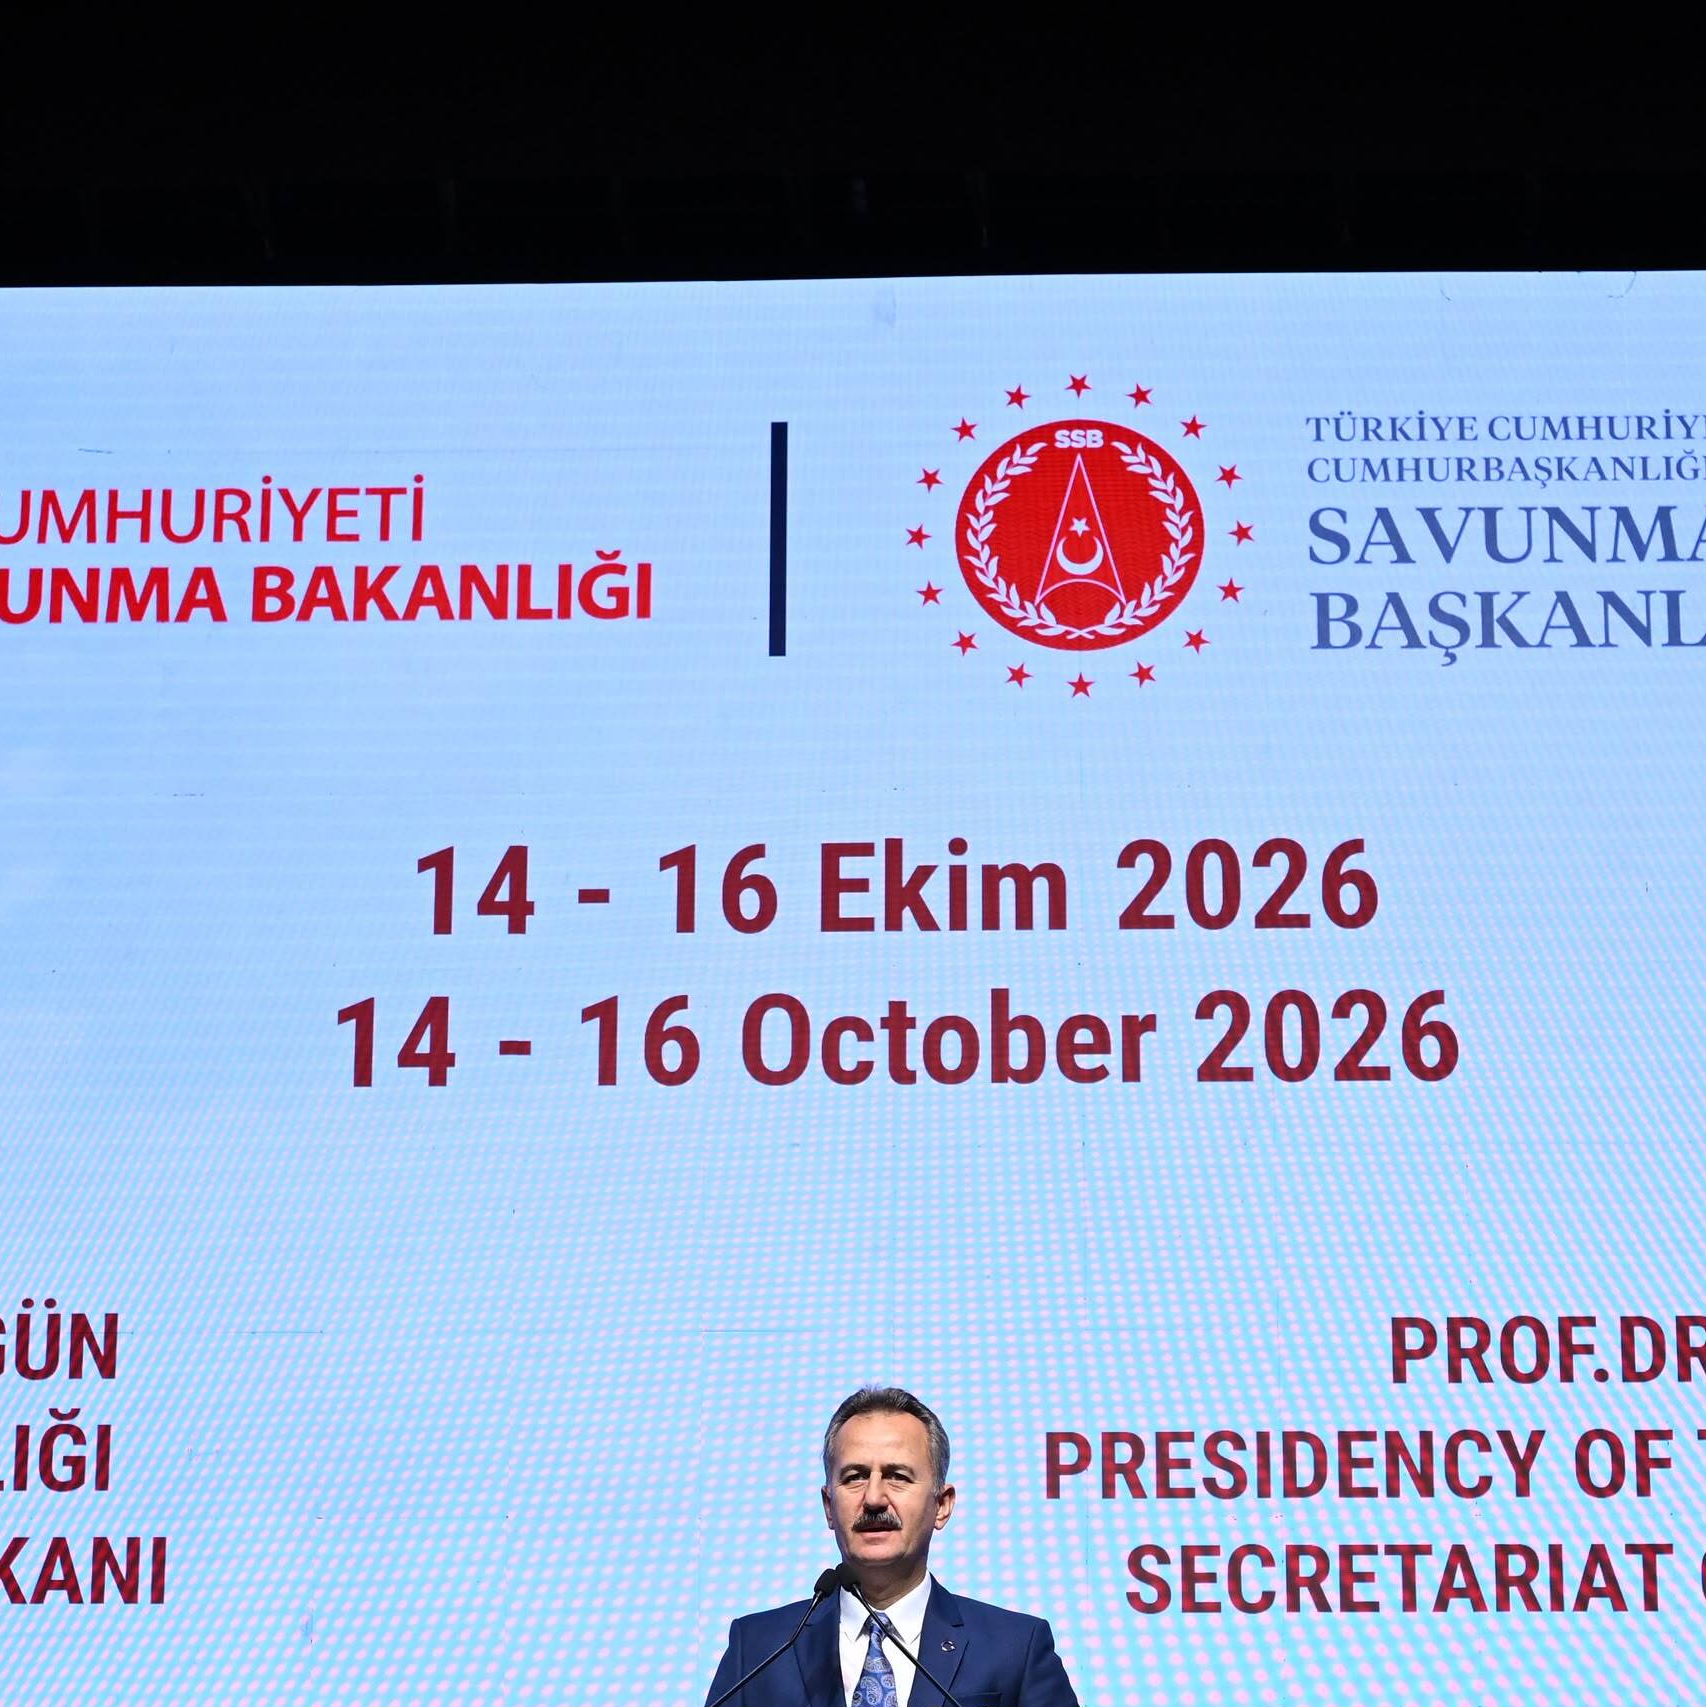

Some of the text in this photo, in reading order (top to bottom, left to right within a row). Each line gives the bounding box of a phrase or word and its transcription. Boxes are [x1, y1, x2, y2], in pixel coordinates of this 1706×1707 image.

[1054, 429, 1104, 449] SSB
[1306, 409, 1479, 442] TÜRKİYE
[251, 550, 653, 622] BAKANLIĞI
[417, 837, 1379, 934] 14 - 16 Ekim 2026
[337, 988, 1459, 1087] 14 - 16 October 2026
[1045, 1430, 1546, 1499] PRESIDENCY
[1575, 1429, 1674, 1498] OF
[1126, 1544, 1674, 1614] SECRETARIAT
